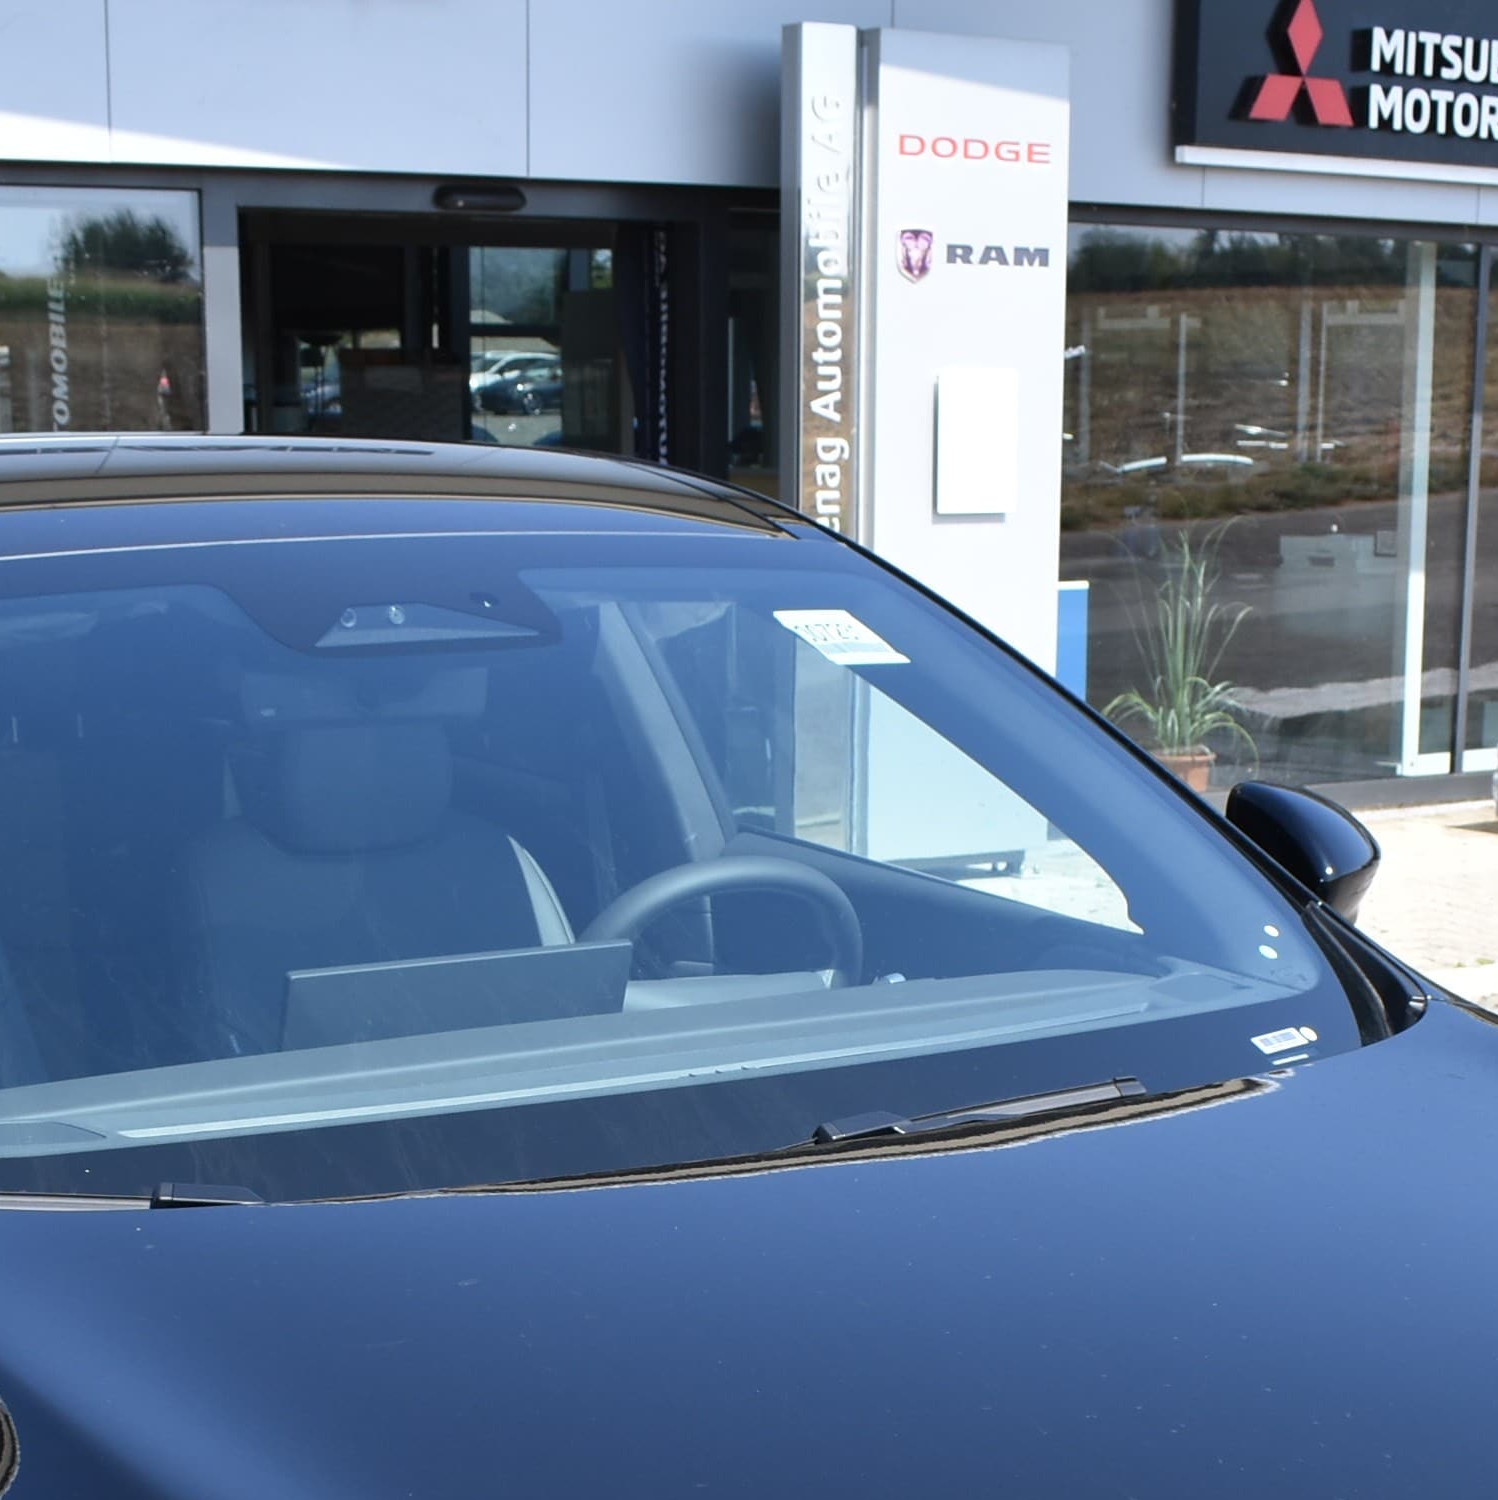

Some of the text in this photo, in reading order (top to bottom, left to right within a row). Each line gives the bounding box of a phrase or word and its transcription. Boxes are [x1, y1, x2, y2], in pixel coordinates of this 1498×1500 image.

[811, 95, 842, 157] AG
[898, 134, 1051, 164] DODGE
[946, 243, 1050, 268] RAM
[807, 171, 842, 421] Automobile
